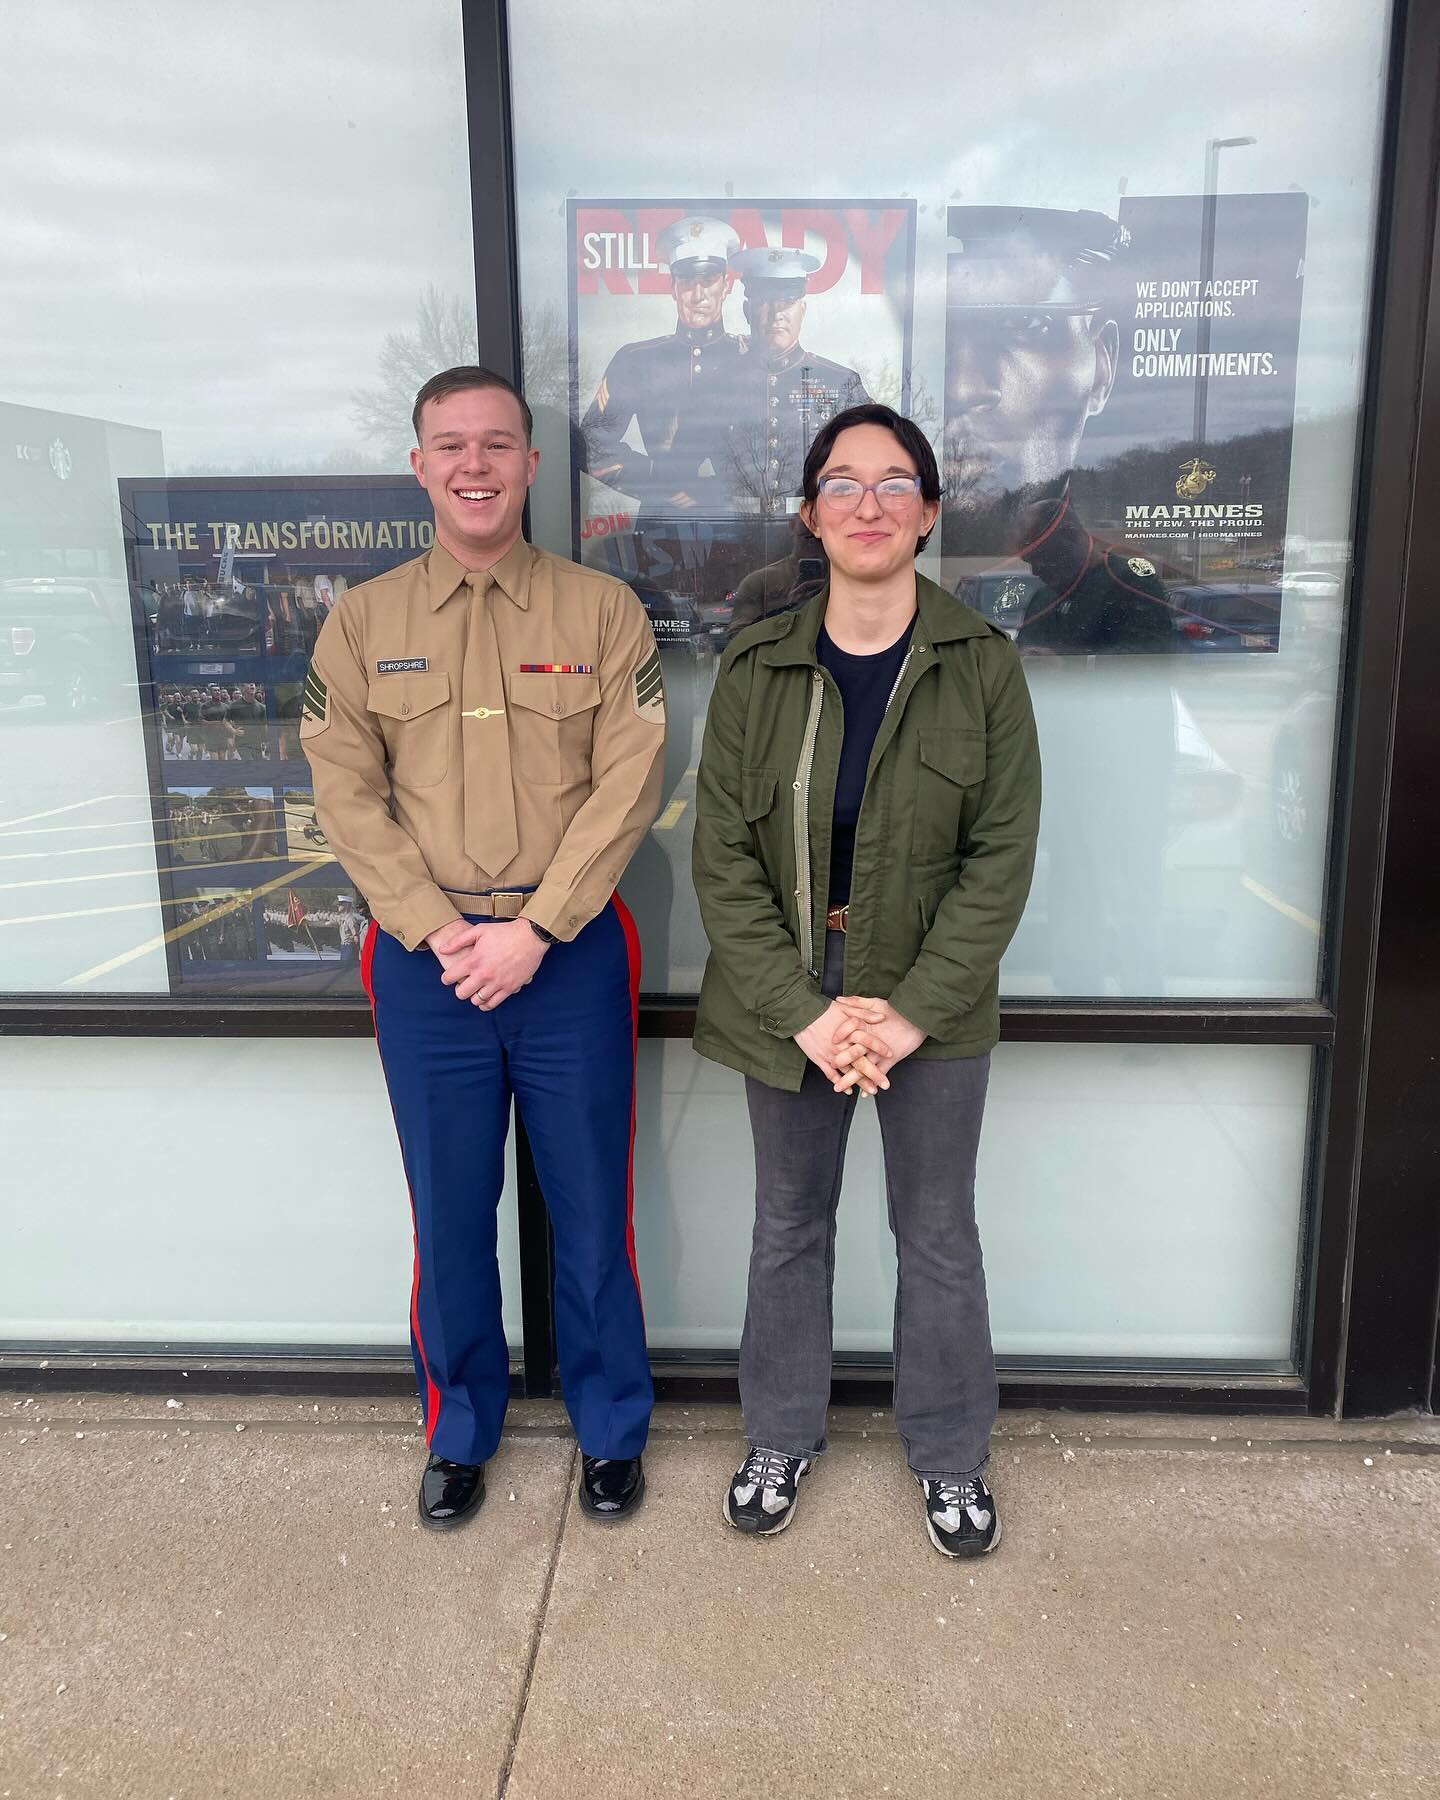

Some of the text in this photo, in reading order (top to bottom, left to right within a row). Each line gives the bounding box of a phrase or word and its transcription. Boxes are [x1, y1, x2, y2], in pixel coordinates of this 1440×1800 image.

[583, 232, 658, 269] STILL
[1136, 279, 1259, 298] WE DON'T ACCEPT
[1135, 300, 1235, 318] APPLICATIONS.
[1133, 328, 1182, 352] ONLY
[1132, 352, 1278, 378] COMMITMENTS.
[1125, 504, 1263, 519] MARINES
[580, 512, 632, 540] JOIN
[1125, 520, 1151, 528] THE
[1155, 520, 1185, 528] FEW.
[1219, 519, 1265, 527] PROUD.
[146, 522, 200, 551] THE
[379, 660, 425, 672] SHROPSHIRE
